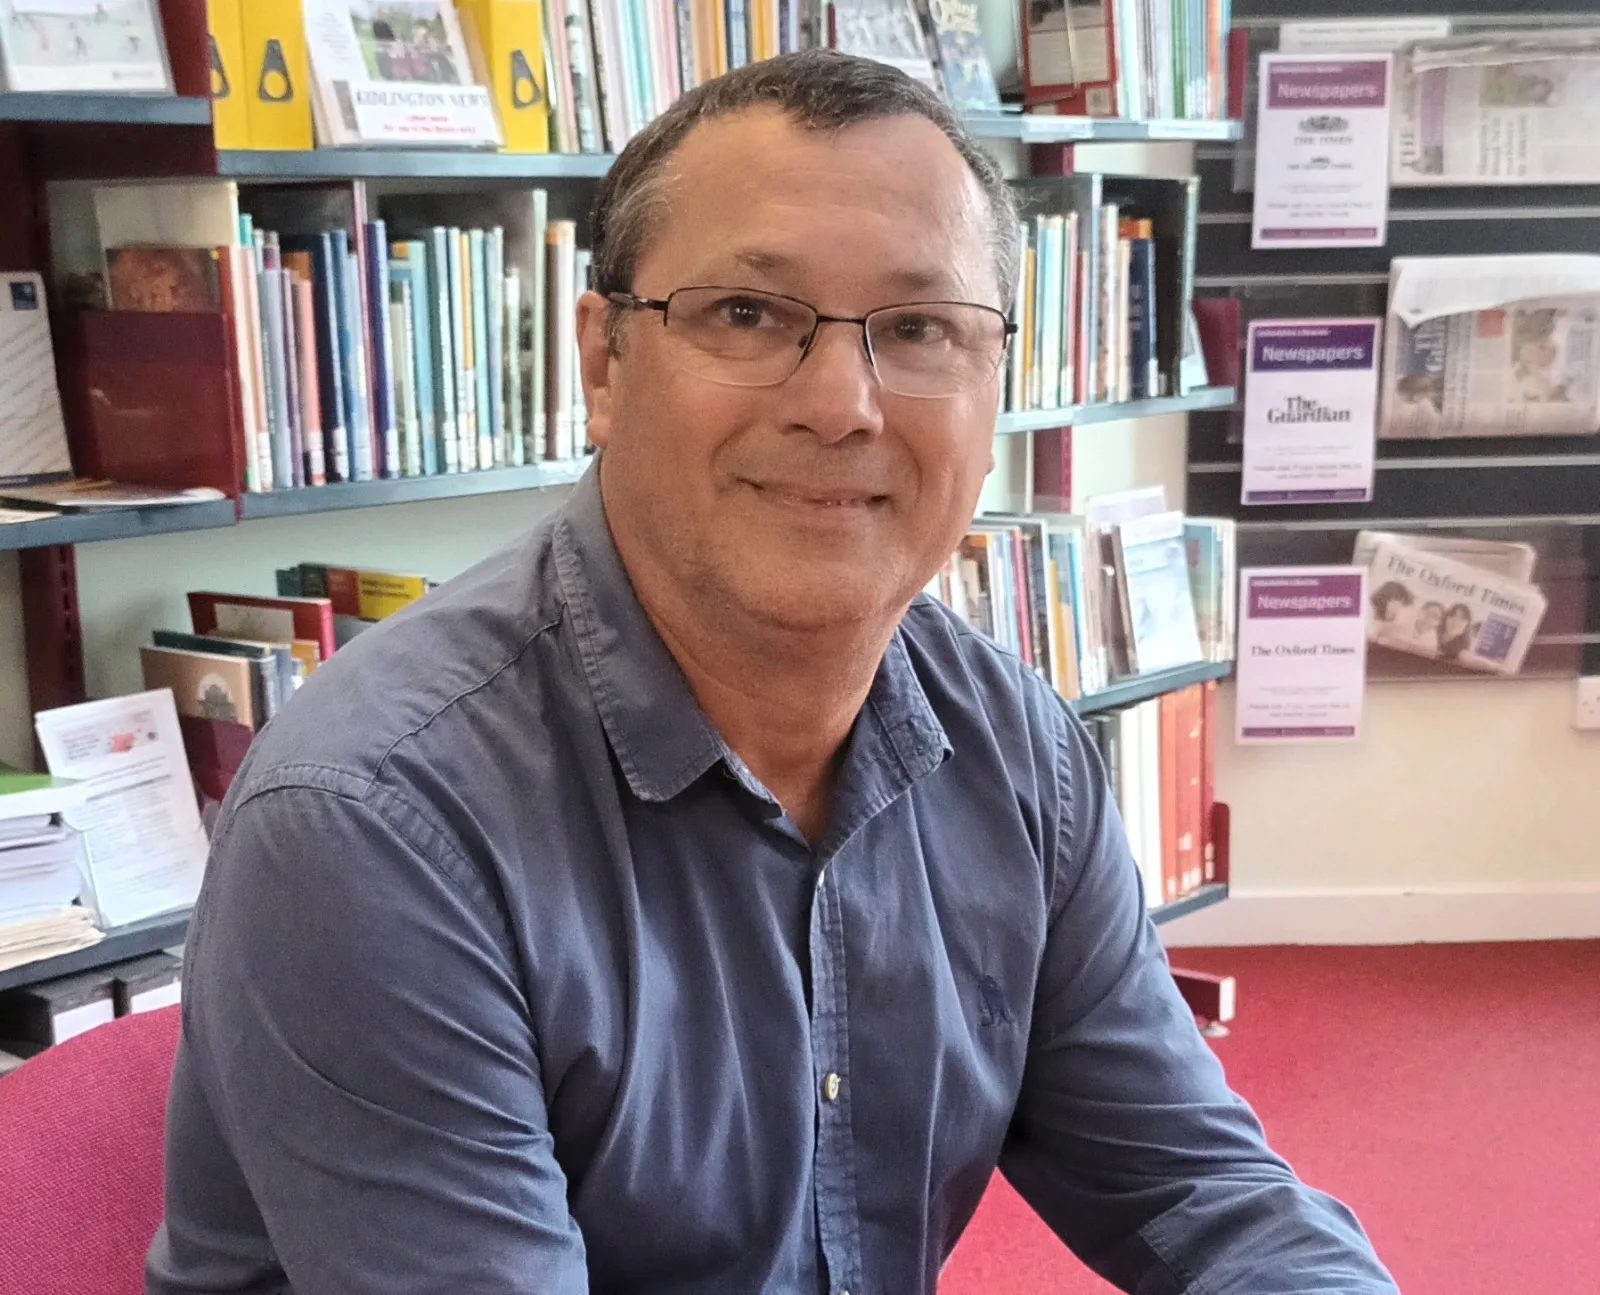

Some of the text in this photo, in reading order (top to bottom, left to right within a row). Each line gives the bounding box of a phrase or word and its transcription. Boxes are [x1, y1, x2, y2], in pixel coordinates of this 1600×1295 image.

[356, 90, 488, 109] KIDLINGTON NEWS
[1277, 83, 1377, 100] Newspapers
[1262, 344, 1365, 363] Newspapers
[1285, 395, 1317, 410] The
[1266, 407, 1351, 424] Guardian
[1387, 556, 1526, 614] The Oxford Times
[1257, 594, 1352, 611] Newspapers
[1251, 644, 1356, 656] The Oxford Times
